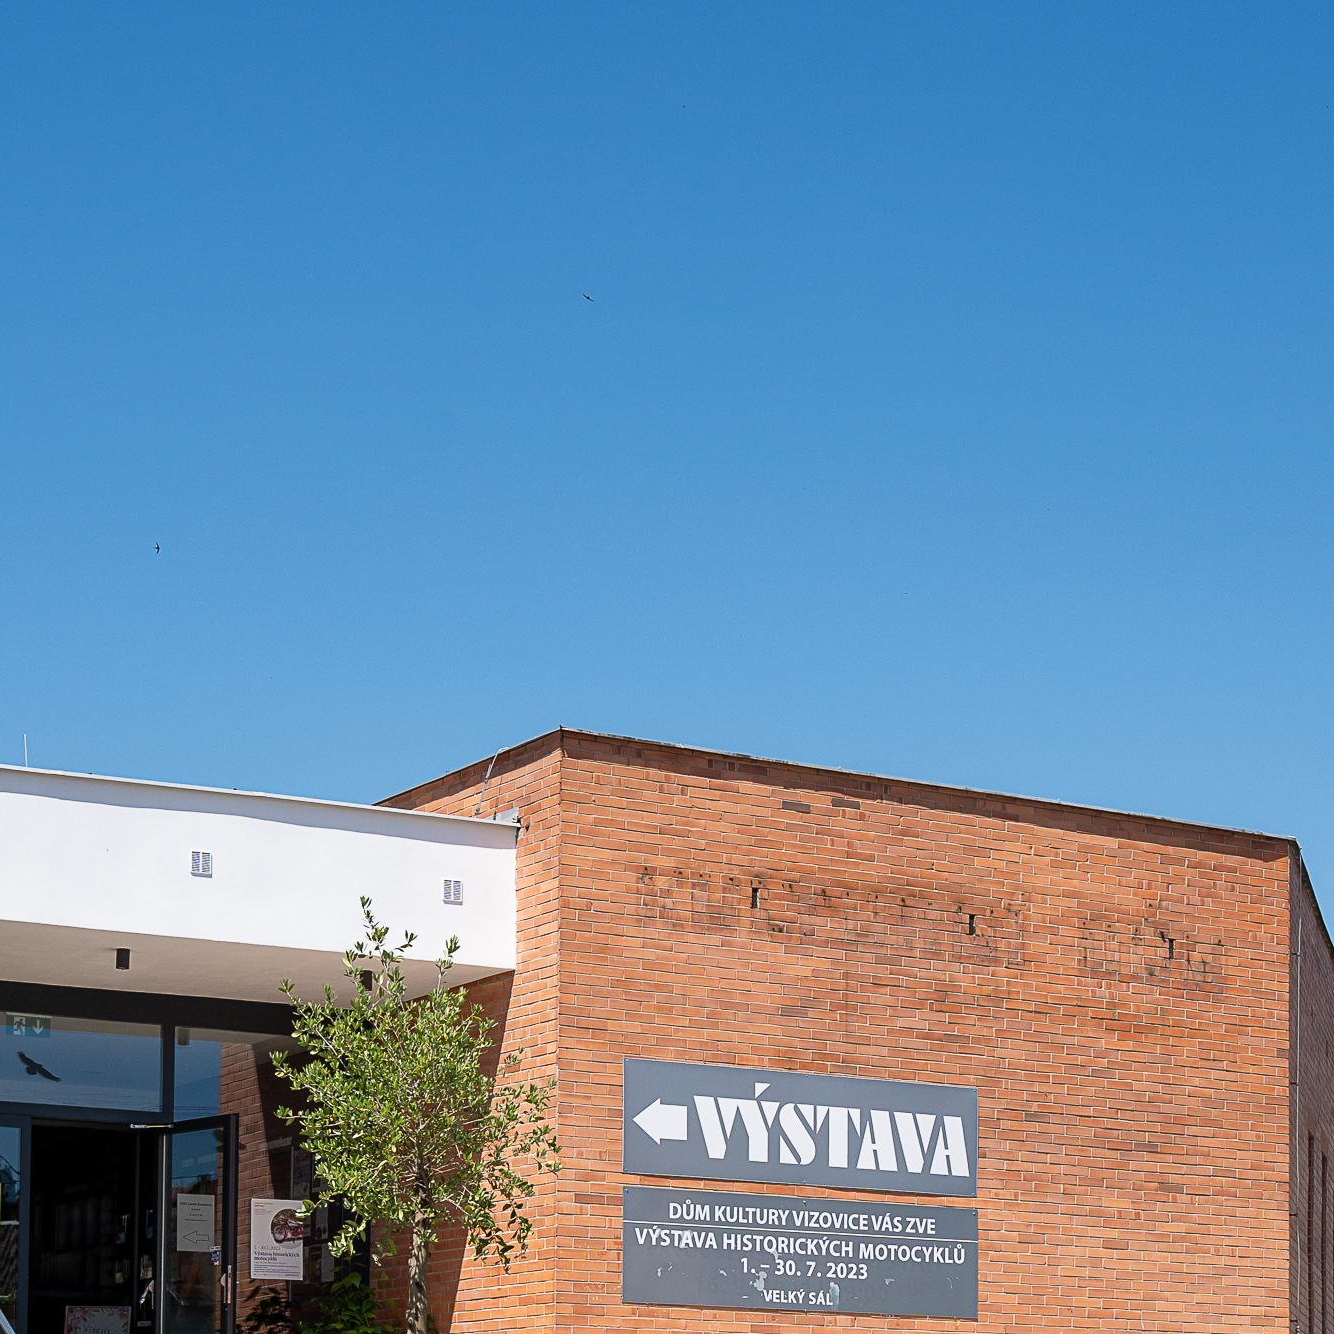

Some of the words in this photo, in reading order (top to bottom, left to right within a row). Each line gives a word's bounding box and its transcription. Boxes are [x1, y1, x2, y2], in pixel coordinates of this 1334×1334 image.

[693, 1082, 970, 1178] VÝSTAVA
[669, 1199, 710, 1221] DŮM
[714, 1205, 789, 1226] KULTURY
[792, 1210, 869, 1231] VIZOVICE
[871, 1213, 903, 1233] VÁS
[905, 1217, 936, 1235] ZVE
[635, 1225, 717, 1249] VÝSTAVA
[722, 1233, 853, 1258] HISTORICKÝCH
[859, 1243, 965, 1265] MOTOCYKLŮ
[740, 1257, 755, 1274] 1.
[774, 1259, 801, 1276] 30.
[806, 1261, 822, 1277] 7.
[826, 1262, 868, 1280] 2023
[763, 1288, 805, 1304] VELKÝ
[808, 1289, 833, 1306] SÁL
